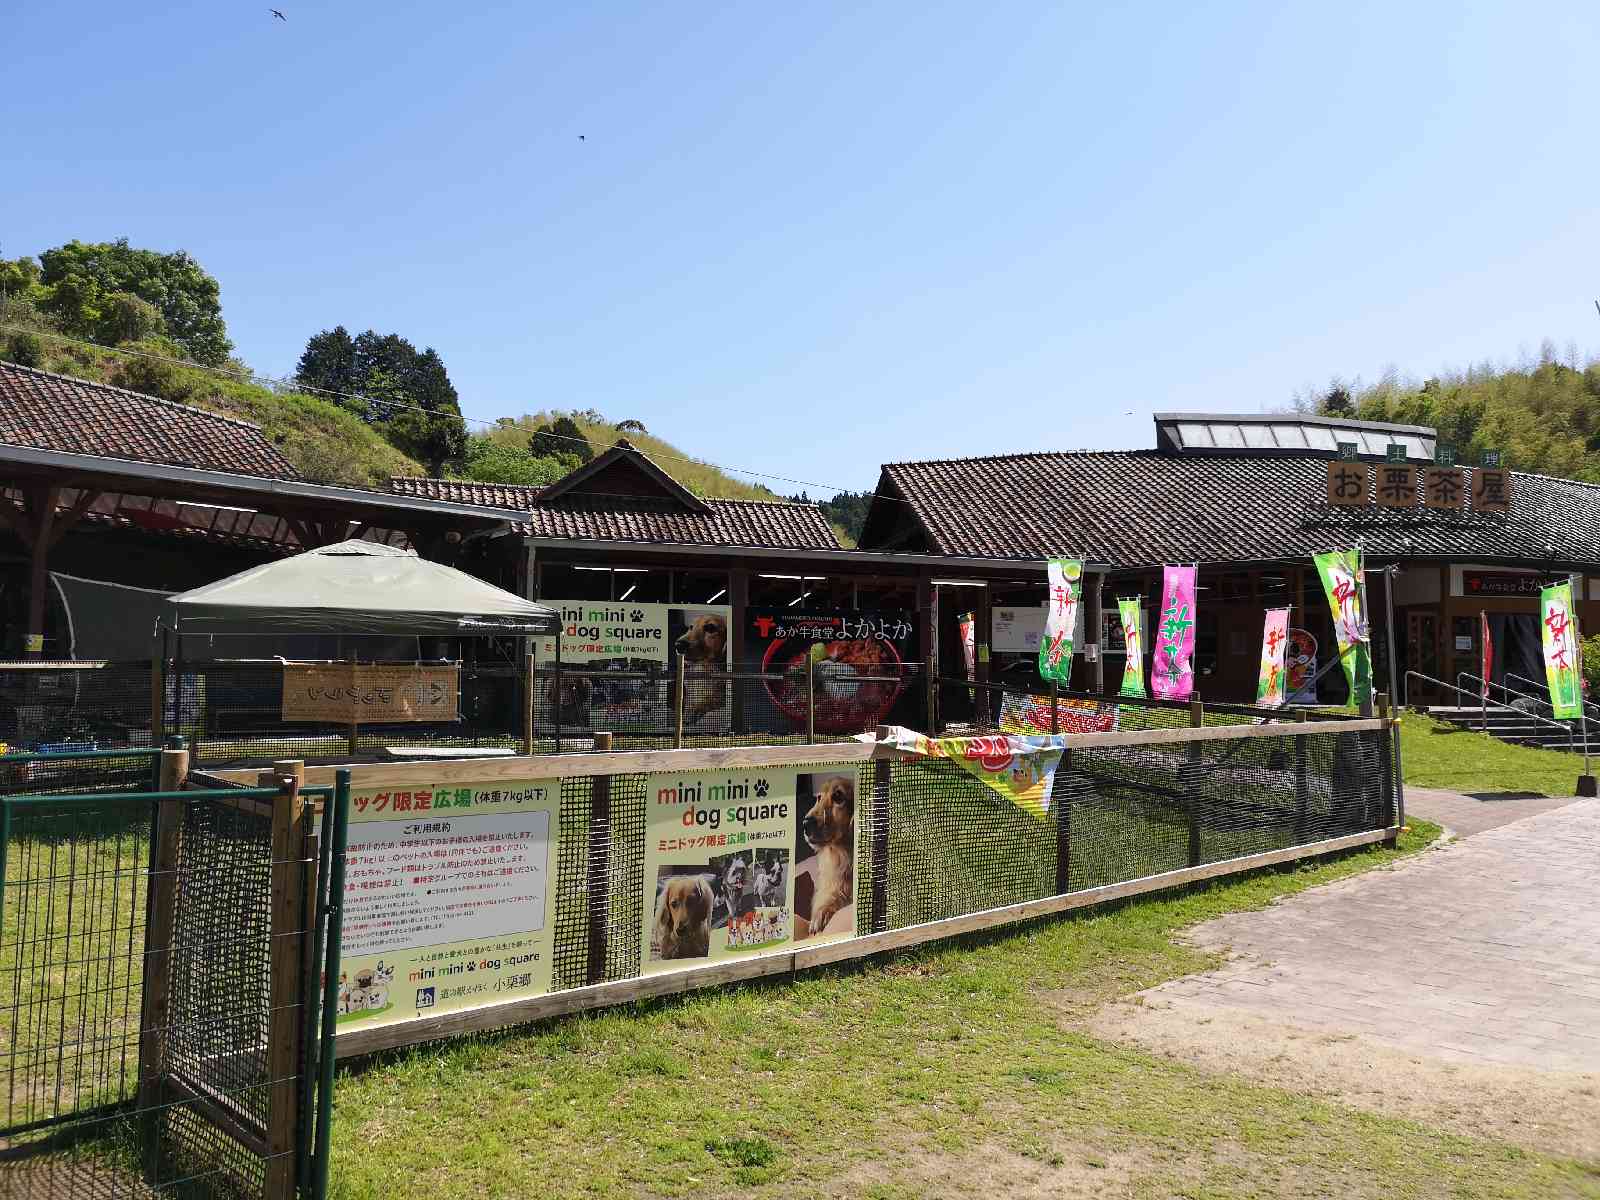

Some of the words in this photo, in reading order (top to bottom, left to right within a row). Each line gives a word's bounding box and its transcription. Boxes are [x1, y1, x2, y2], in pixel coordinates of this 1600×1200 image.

[1334, 467, 1507, 505] お栗茶屋
[562, 606, 583, 621] ini
[589, 608, 624, 622] mini
[567, 623, 600, 641] dog
[605, 627, 662, 642] square
[775, 627, 834, 640] あか牛食堂
[836, 617, 913, 640] よかよか
[544, 642, 623, 654] ミドッグ限定広場
[353, 788, 472, 813] ッグ限定広場
[474, 786, 549, 805] (体重7kg以下)
[657, 781, 701, 805] mini
[708, 778, 748, 800] mini
[682, 805, 721, 829] dog
[726, 803, 788, 826] square
[403, 822, 451, 835] ご利用規約
[656, 831, 747, 851] ミニドッグ限定広場
[409, 967, 436, 982] mini
[439, 962, 464, 976] mini
[479, 958, 501, 970] dog
[503, 952, 541, 966] square
